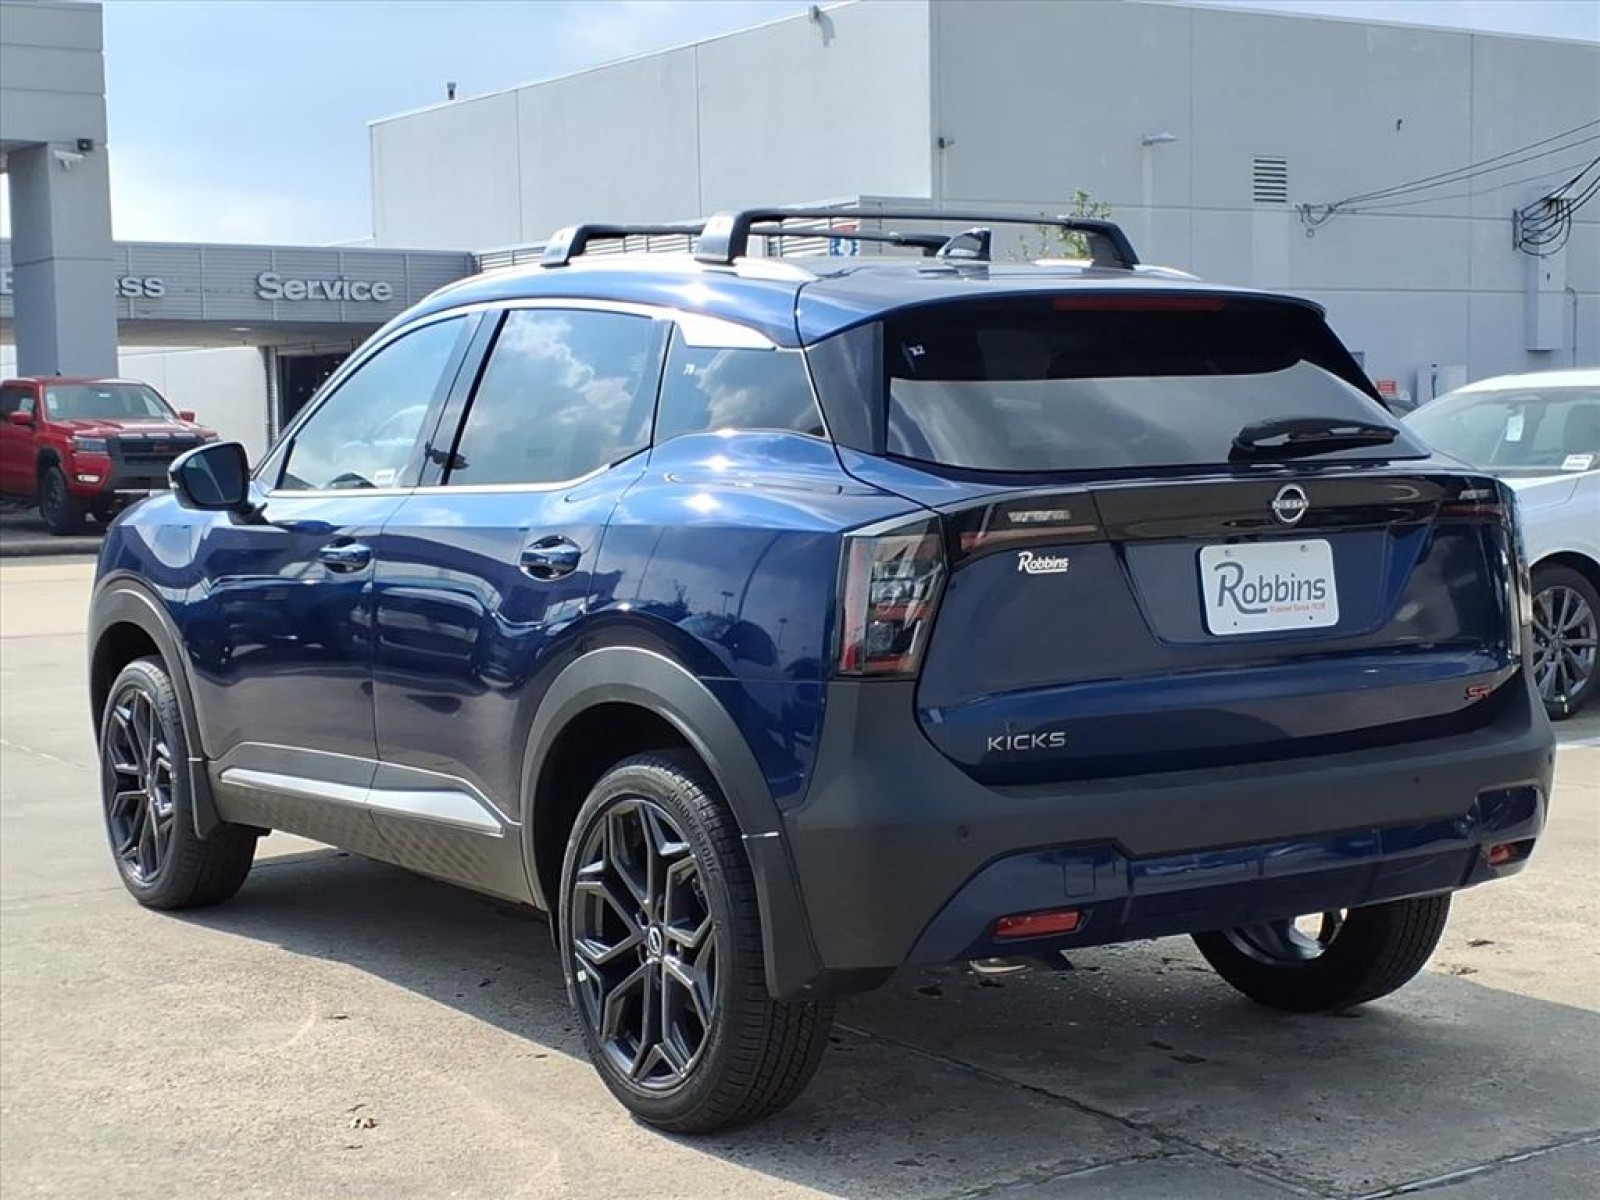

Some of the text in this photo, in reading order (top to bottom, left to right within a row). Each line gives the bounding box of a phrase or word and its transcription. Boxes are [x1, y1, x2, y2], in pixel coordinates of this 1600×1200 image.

[257, 271, 393, 301] Service
[1018, 551, 1069, 574] Robbins
[1213, 561, 1326, 614] Robbins
[987, 732, 1066, 751] KICKS
